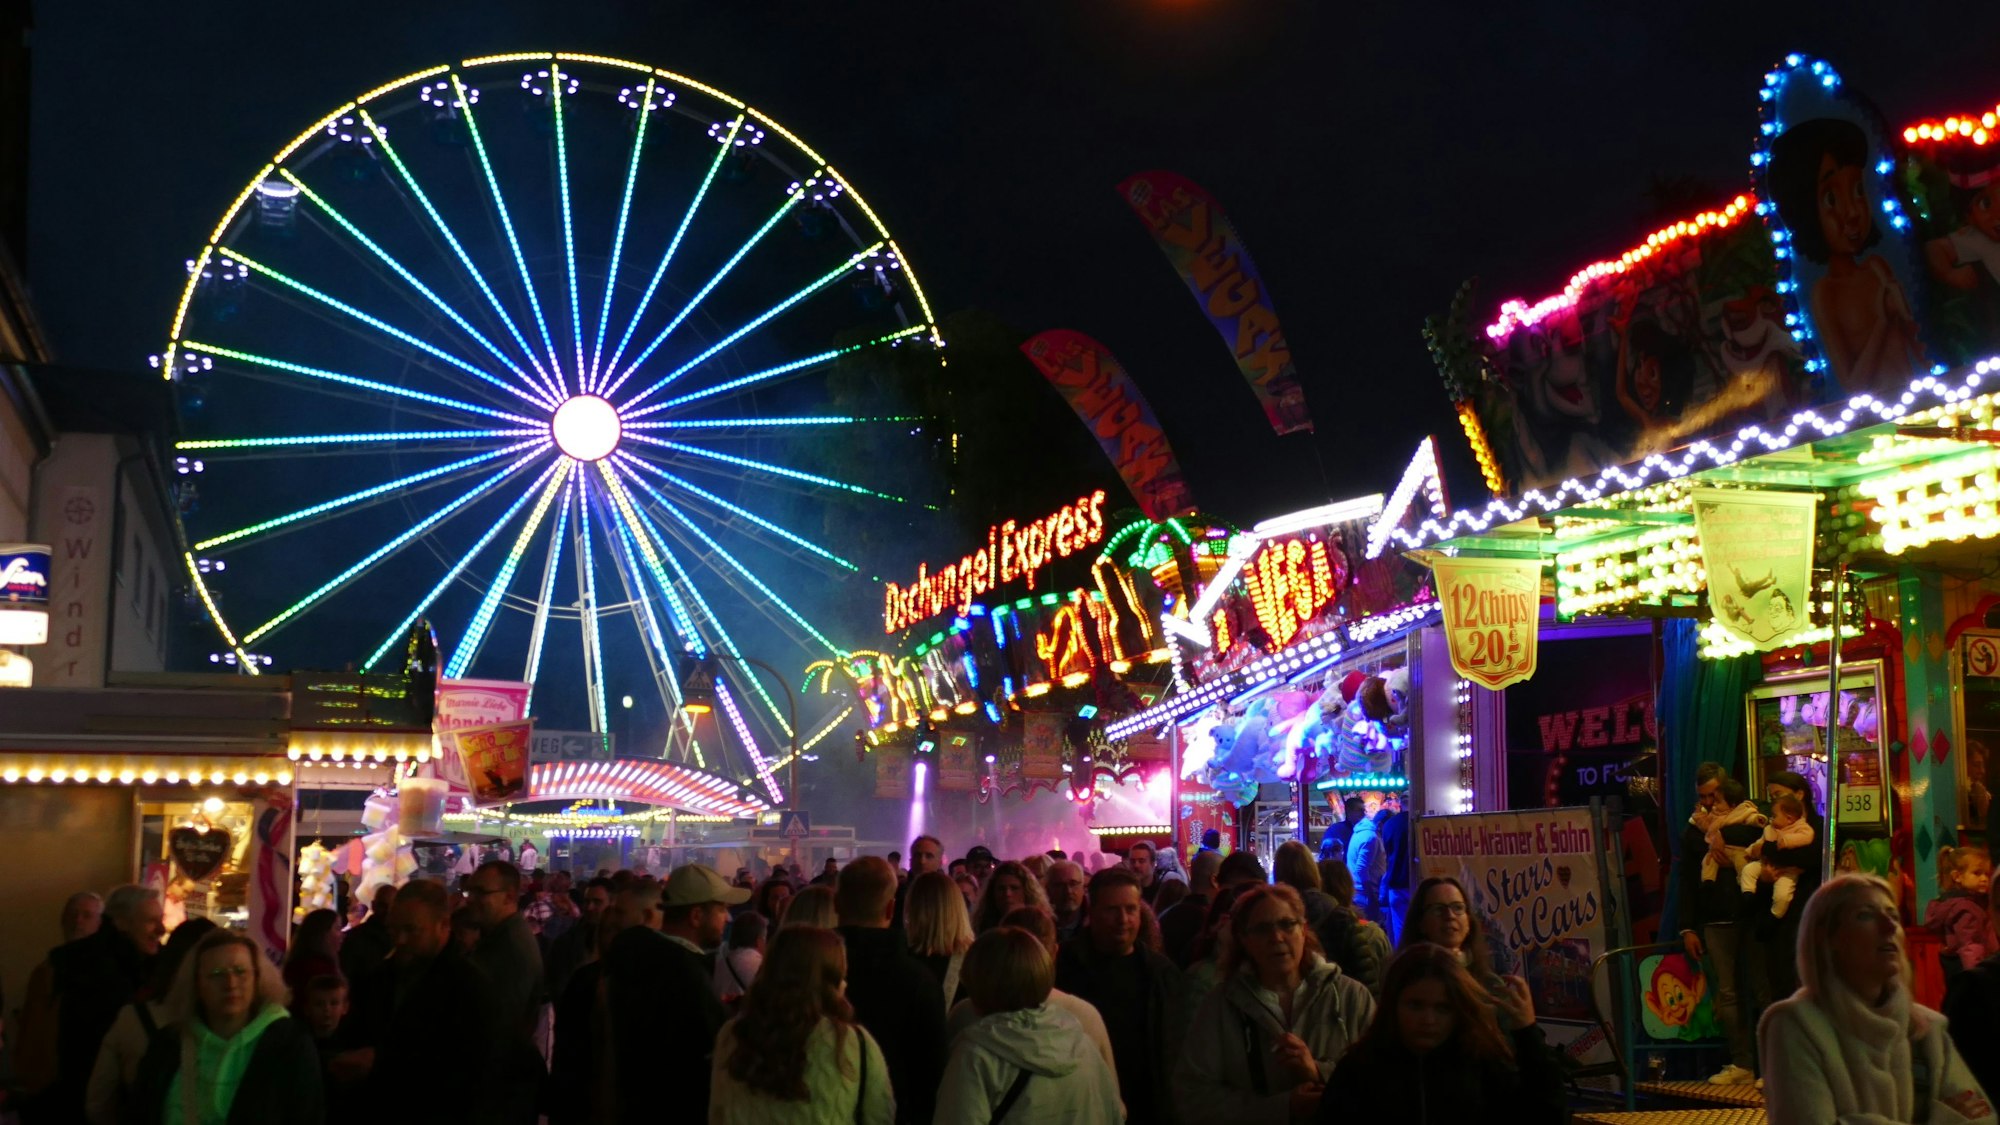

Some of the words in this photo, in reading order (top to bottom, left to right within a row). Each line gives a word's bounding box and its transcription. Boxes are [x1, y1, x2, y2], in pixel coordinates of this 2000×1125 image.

[1163, 200, 1293, 387] VEGAS
[1054, 347, 1173, 489] VEGAS
[885, 525, 997, 634] Dschungel
[1002, 489, 1105, 591] Express
[1577, 766, 1597, 785] TO
[1846, 794, 1872, 811] 538
[1423, 825, 1532, 856] Osthold-Krämer
[1535, 823, 1548, 854] &
[1550, 821, 1591, 854] Sohn
[1486, 857, 1554, 915] Stars
